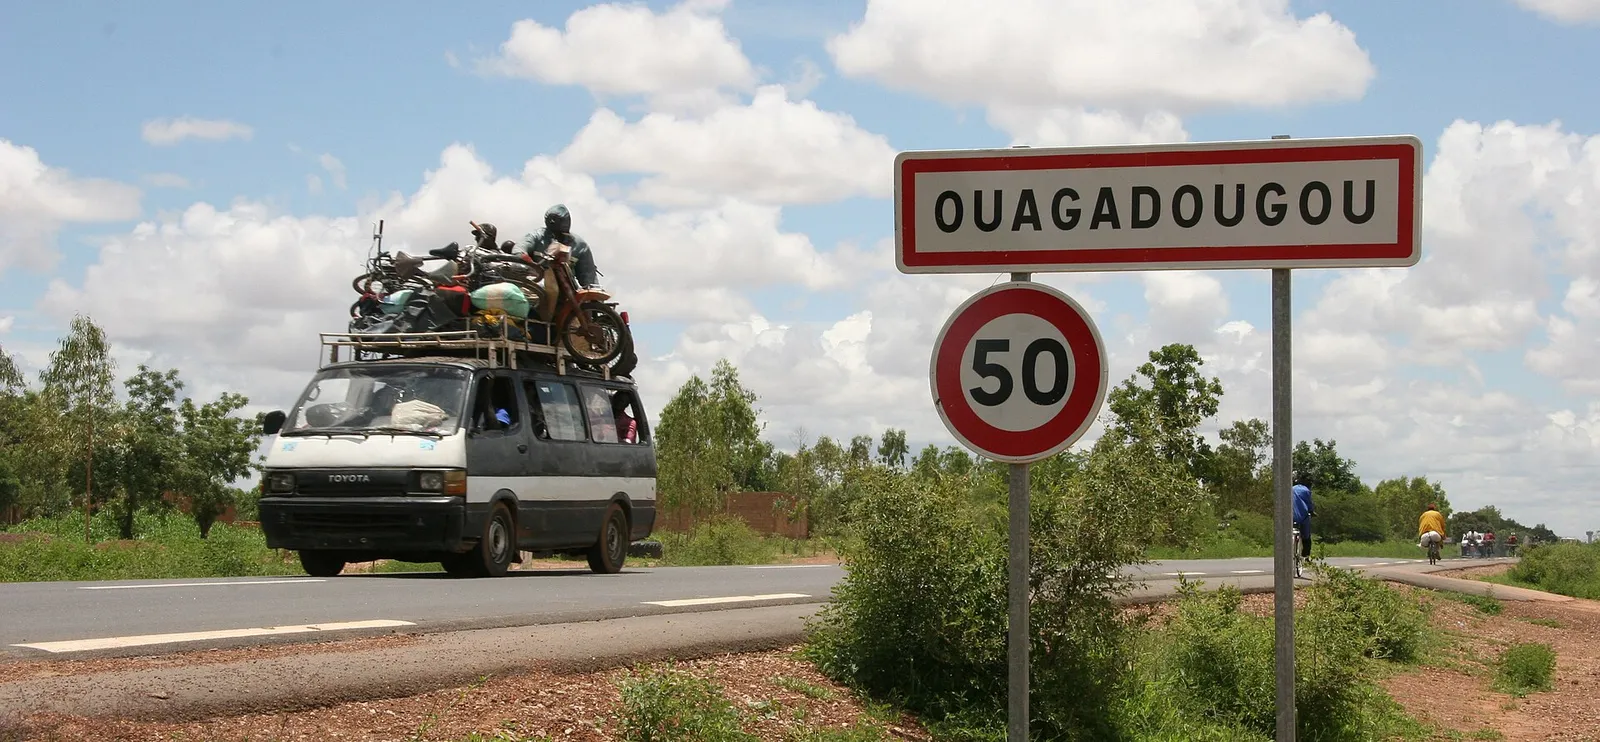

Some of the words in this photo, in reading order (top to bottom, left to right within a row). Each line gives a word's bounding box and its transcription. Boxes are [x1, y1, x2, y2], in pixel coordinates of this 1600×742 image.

[934, 179, 1376, 234] OUAGADOUGOU
[968, 337, 1070, 407] 50
[328, 474, 370, 483] TOYOTA
